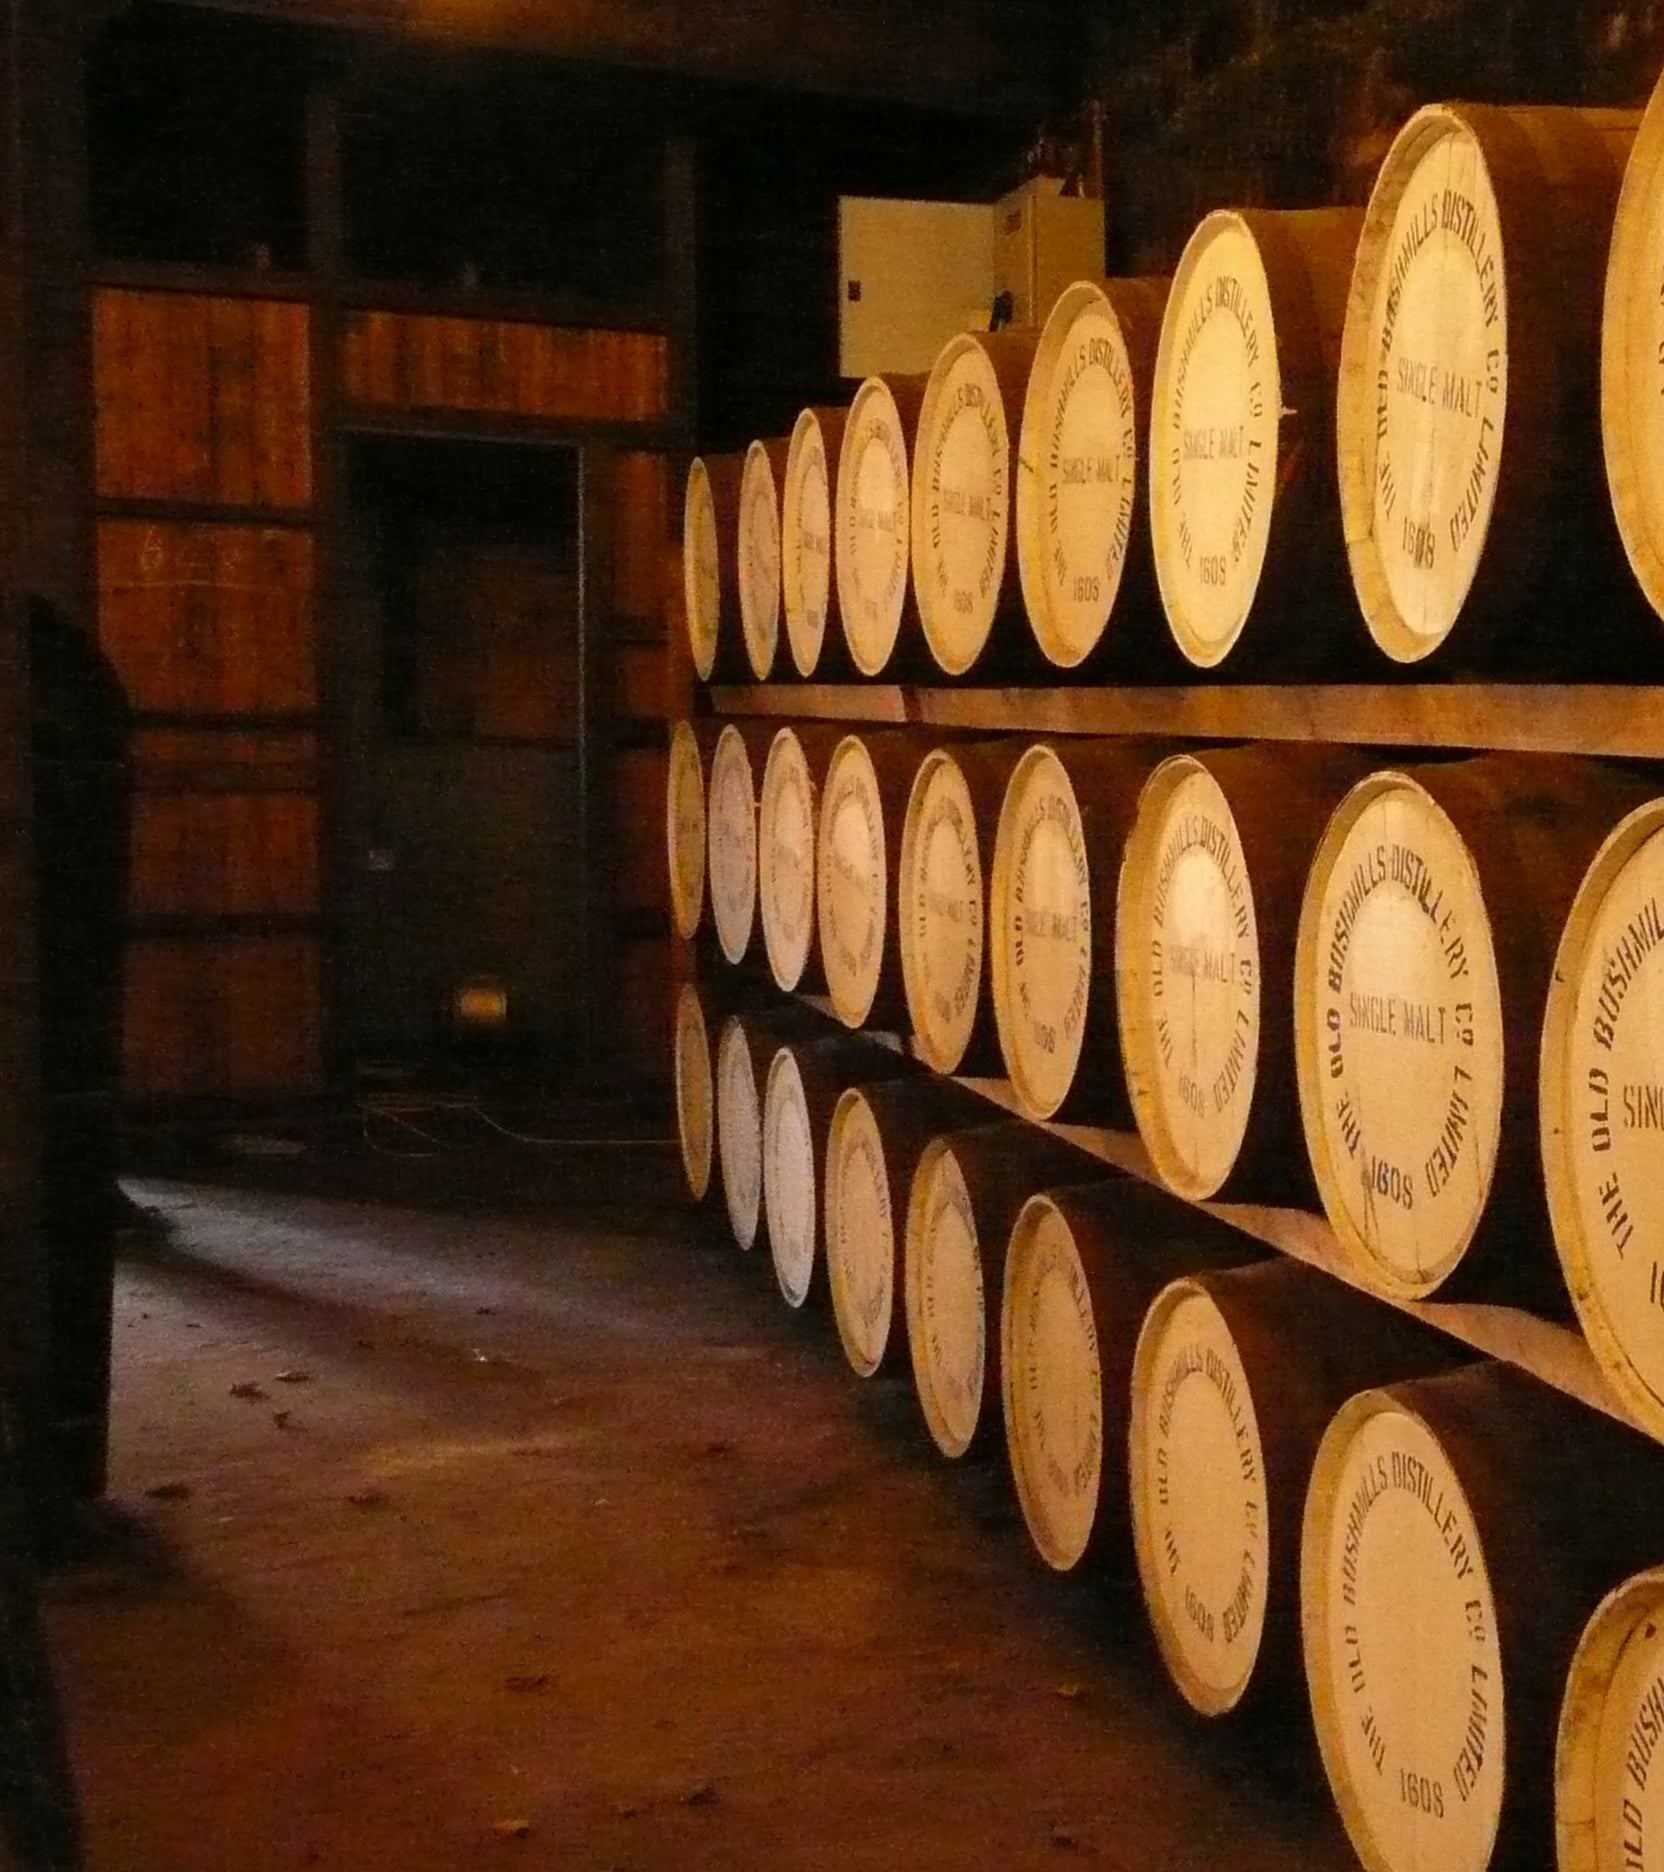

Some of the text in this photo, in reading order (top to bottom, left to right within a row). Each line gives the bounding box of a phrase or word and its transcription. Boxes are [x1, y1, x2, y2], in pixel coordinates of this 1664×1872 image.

[1326, 1008, 1344, 1079] OLD
[1349, 991, 1446, 1046] SINGLE MALT
[1336, 1090, 1361, 1160] THE
[1588, 1068, 1612, 1152] OLD
[1371, 1154, 1413, 1210] 1608
[1599, 1172, 1634, 1260] THE
